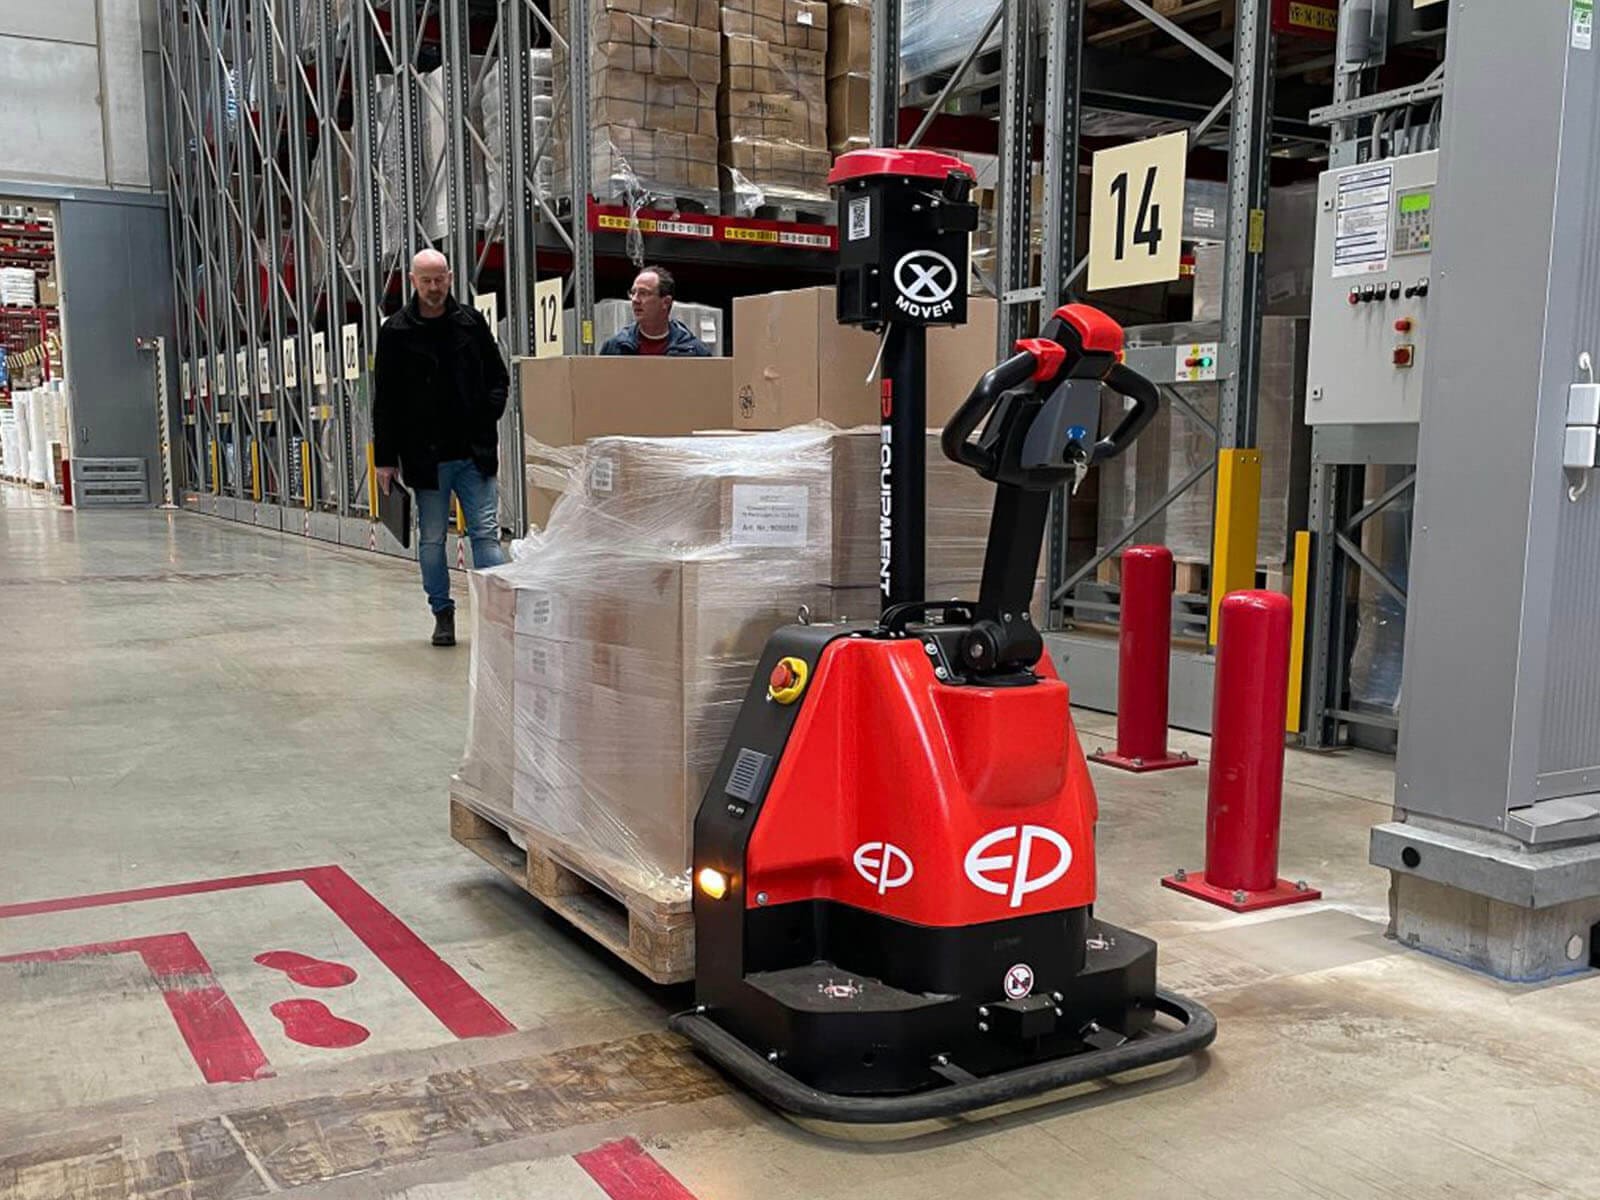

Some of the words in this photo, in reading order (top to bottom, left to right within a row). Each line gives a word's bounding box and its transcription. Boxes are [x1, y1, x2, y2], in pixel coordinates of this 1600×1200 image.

[1110, 166, 1162, 260] 14
[541, 294, 558, 344] 12
[895, 294, 954, 318] MOVER
[881, 378, 893, 418] EP
[880, 424, 893, 598] EQUIPMENT
[853, 841, 914, 895] EP
[964, 824, 1073, 907] EP
